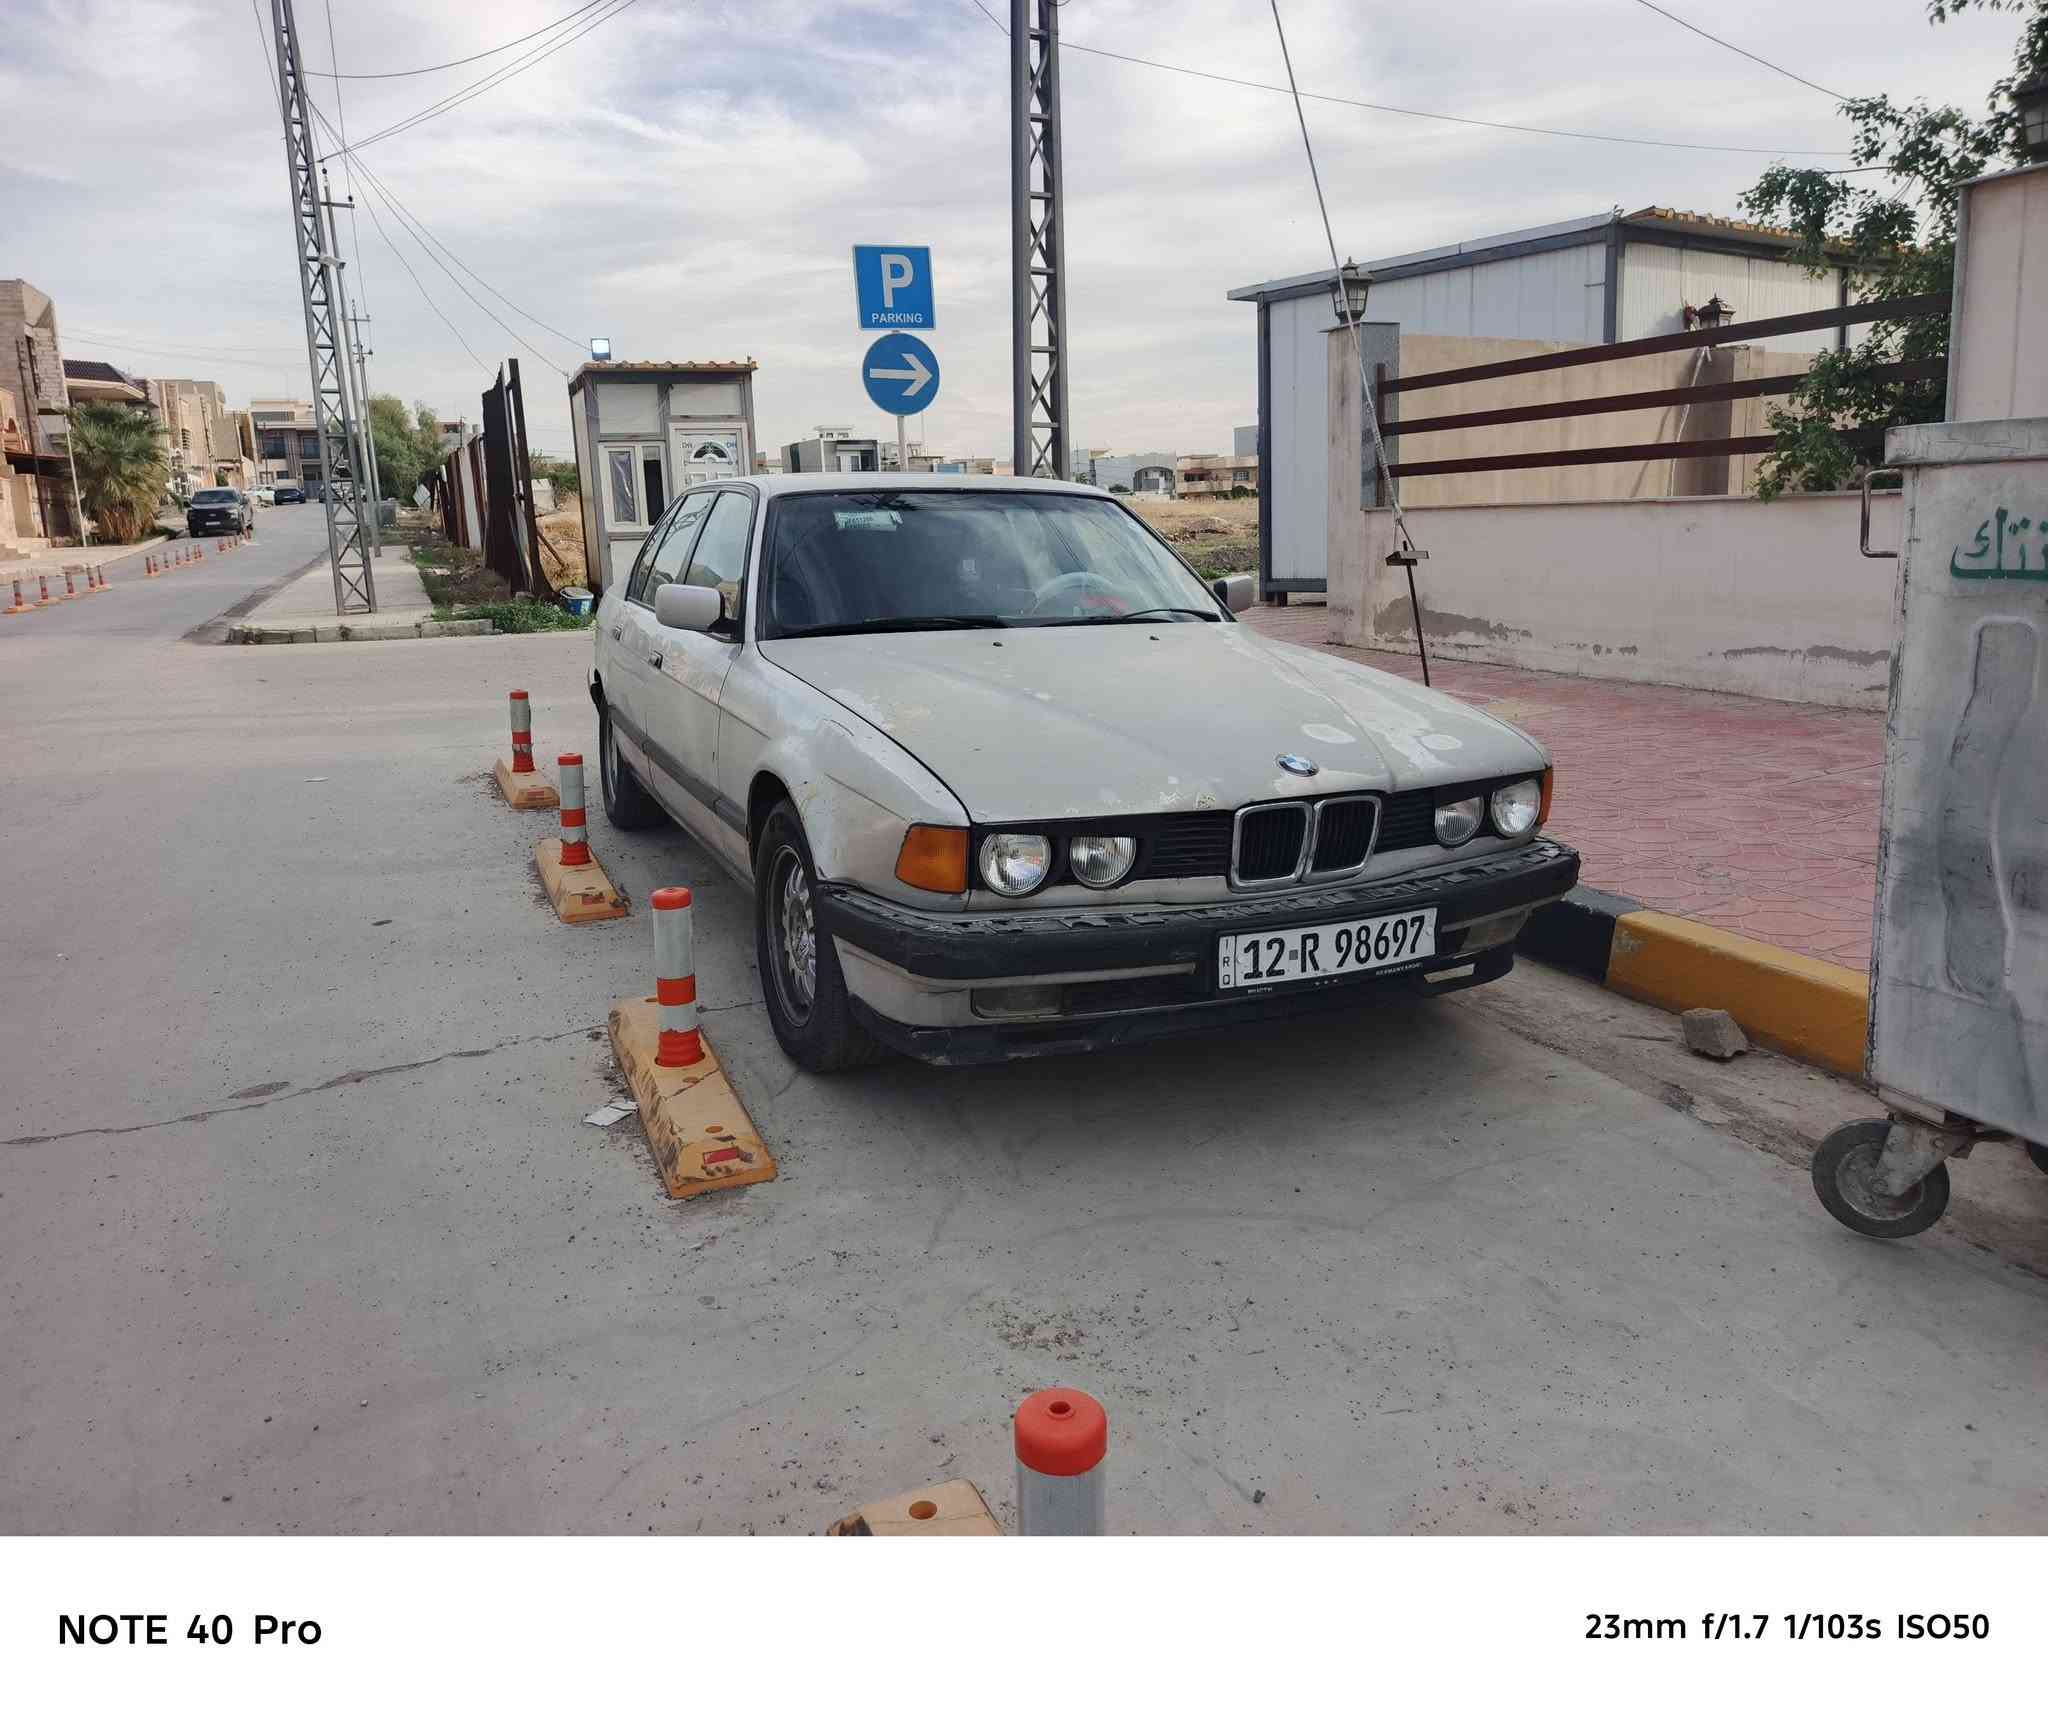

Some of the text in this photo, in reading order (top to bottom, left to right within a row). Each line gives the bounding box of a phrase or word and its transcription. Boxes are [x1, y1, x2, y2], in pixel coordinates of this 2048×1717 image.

[880, 254, 914, 308] P
[871, 313, 923, 324] PARKING
[1335, 915, 1426, 968] 98697
